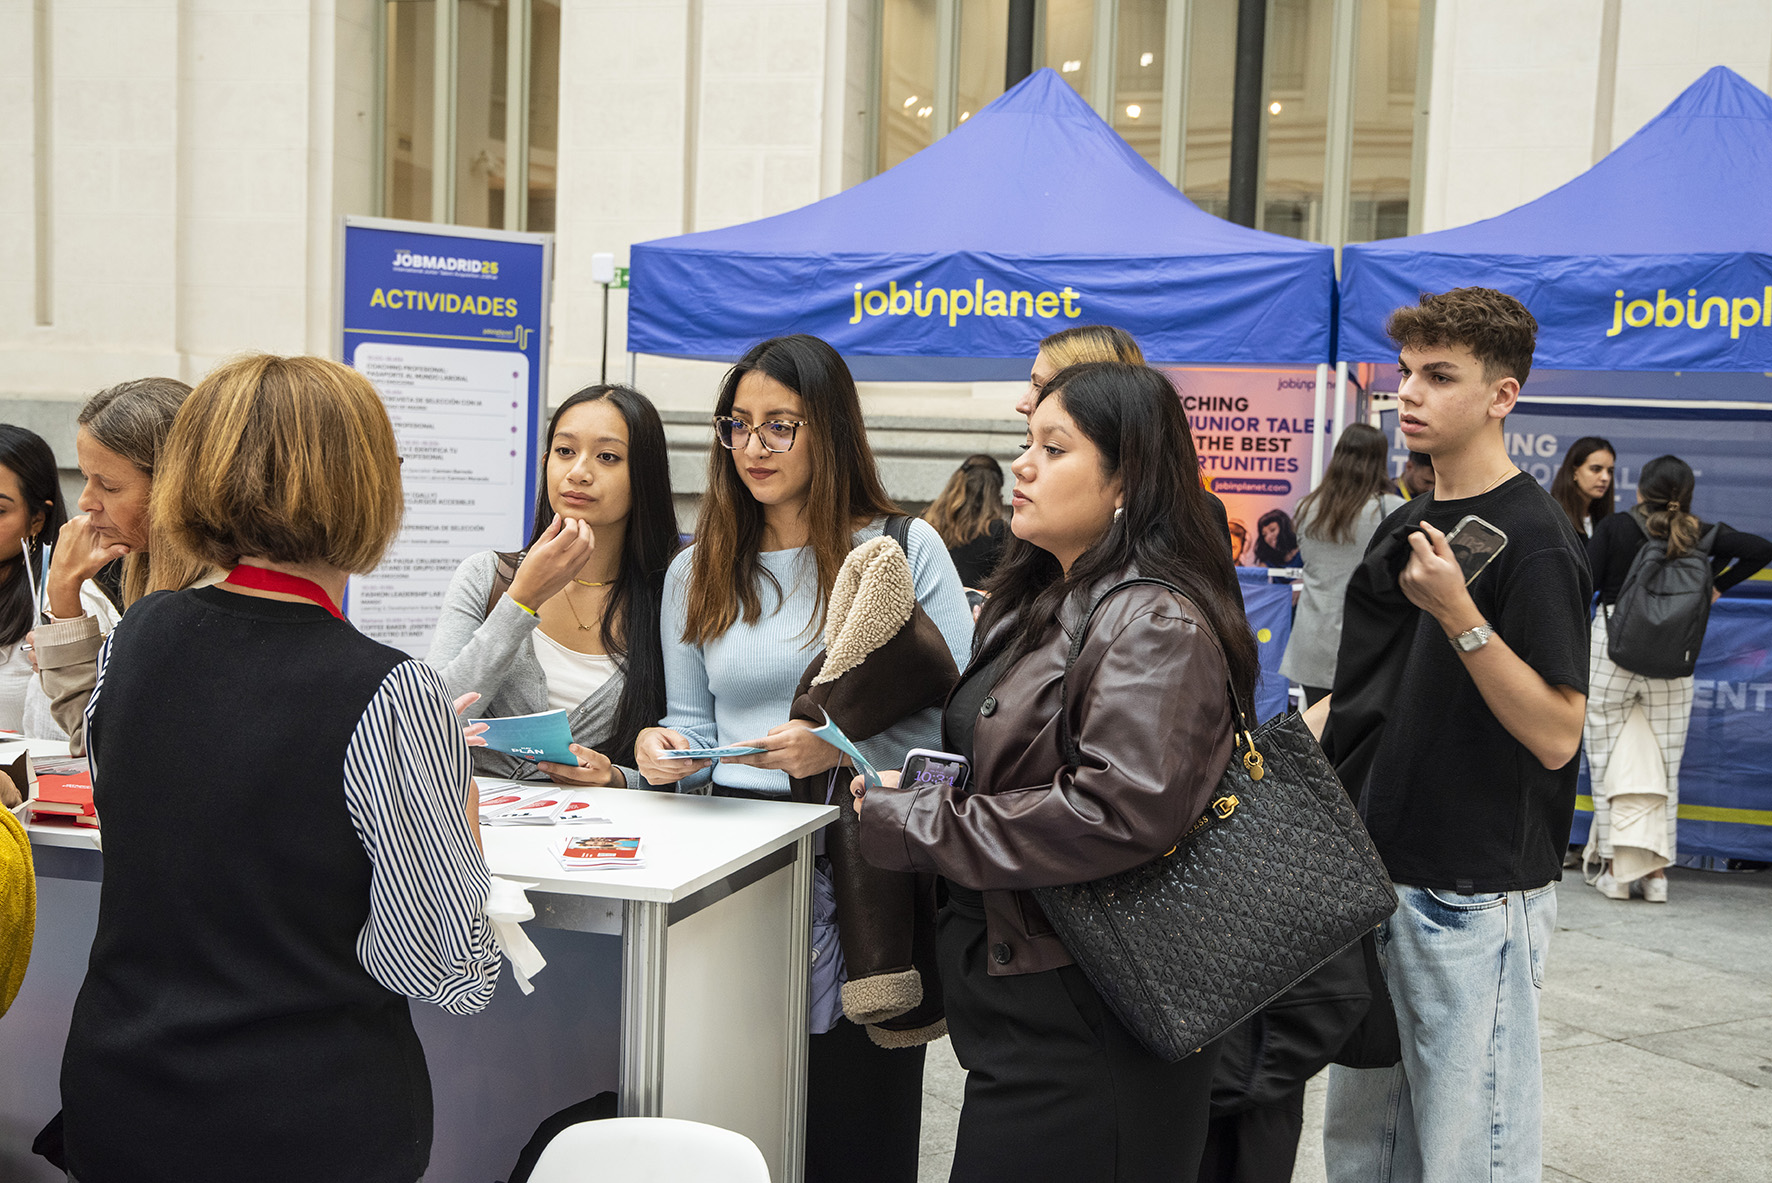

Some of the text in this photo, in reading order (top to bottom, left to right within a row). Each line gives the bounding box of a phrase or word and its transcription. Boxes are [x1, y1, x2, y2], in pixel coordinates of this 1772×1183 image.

[392, 253, 499, 274] JOBMADRID25
[370, 287, 519, 318] ACTIVIDADES
[849, 278, 1082, 327] jobinplanet
[1606, 285, 1772, 339] jobinpl
[1180, 396, 1249, 412] CHING
[1266, 417, 1334, 434] TALEN
[1196, 436, 1292, 452] THE BEST
[1198, 455, 1299, 473] RTUNITIES
[1214, 481, 1289, 492] jobinplanet.com
[1693, 679, 1772, 712] ENT
[511, 747, 545, 755] PLAN
